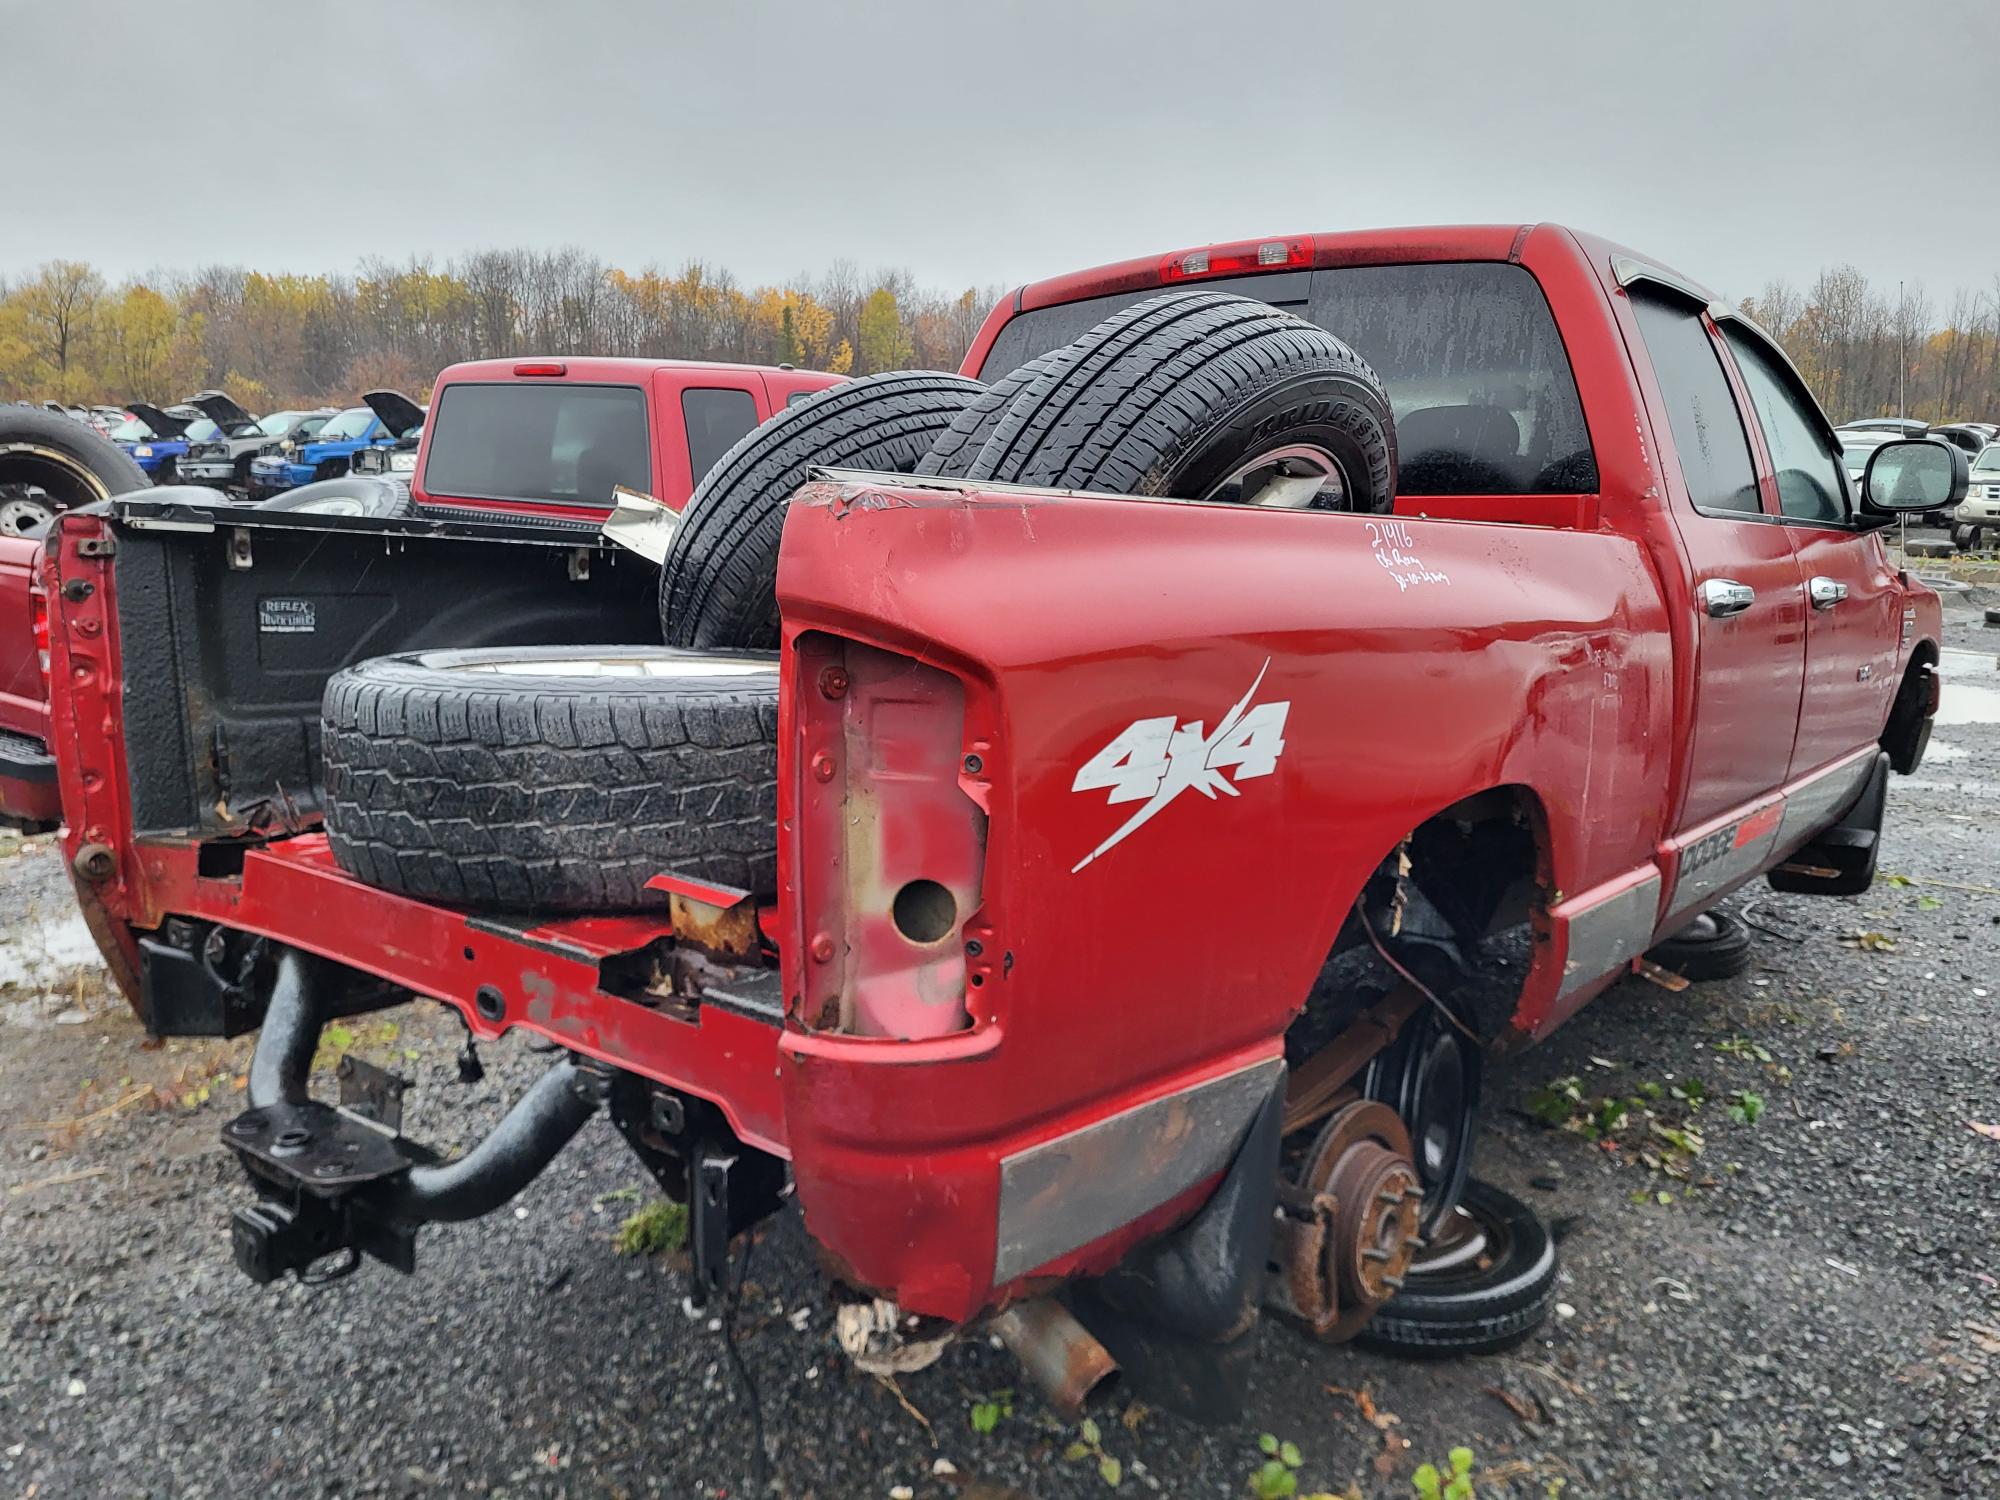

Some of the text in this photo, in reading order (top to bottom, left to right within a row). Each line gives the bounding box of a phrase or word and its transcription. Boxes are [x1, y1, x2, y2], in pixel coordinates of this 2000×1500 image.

[1243, 400, 1388, 505] BRIDGESTONE
[266, 600, 309, 614] REFLEX
[1681, 824, 1738, 878] DODGE
